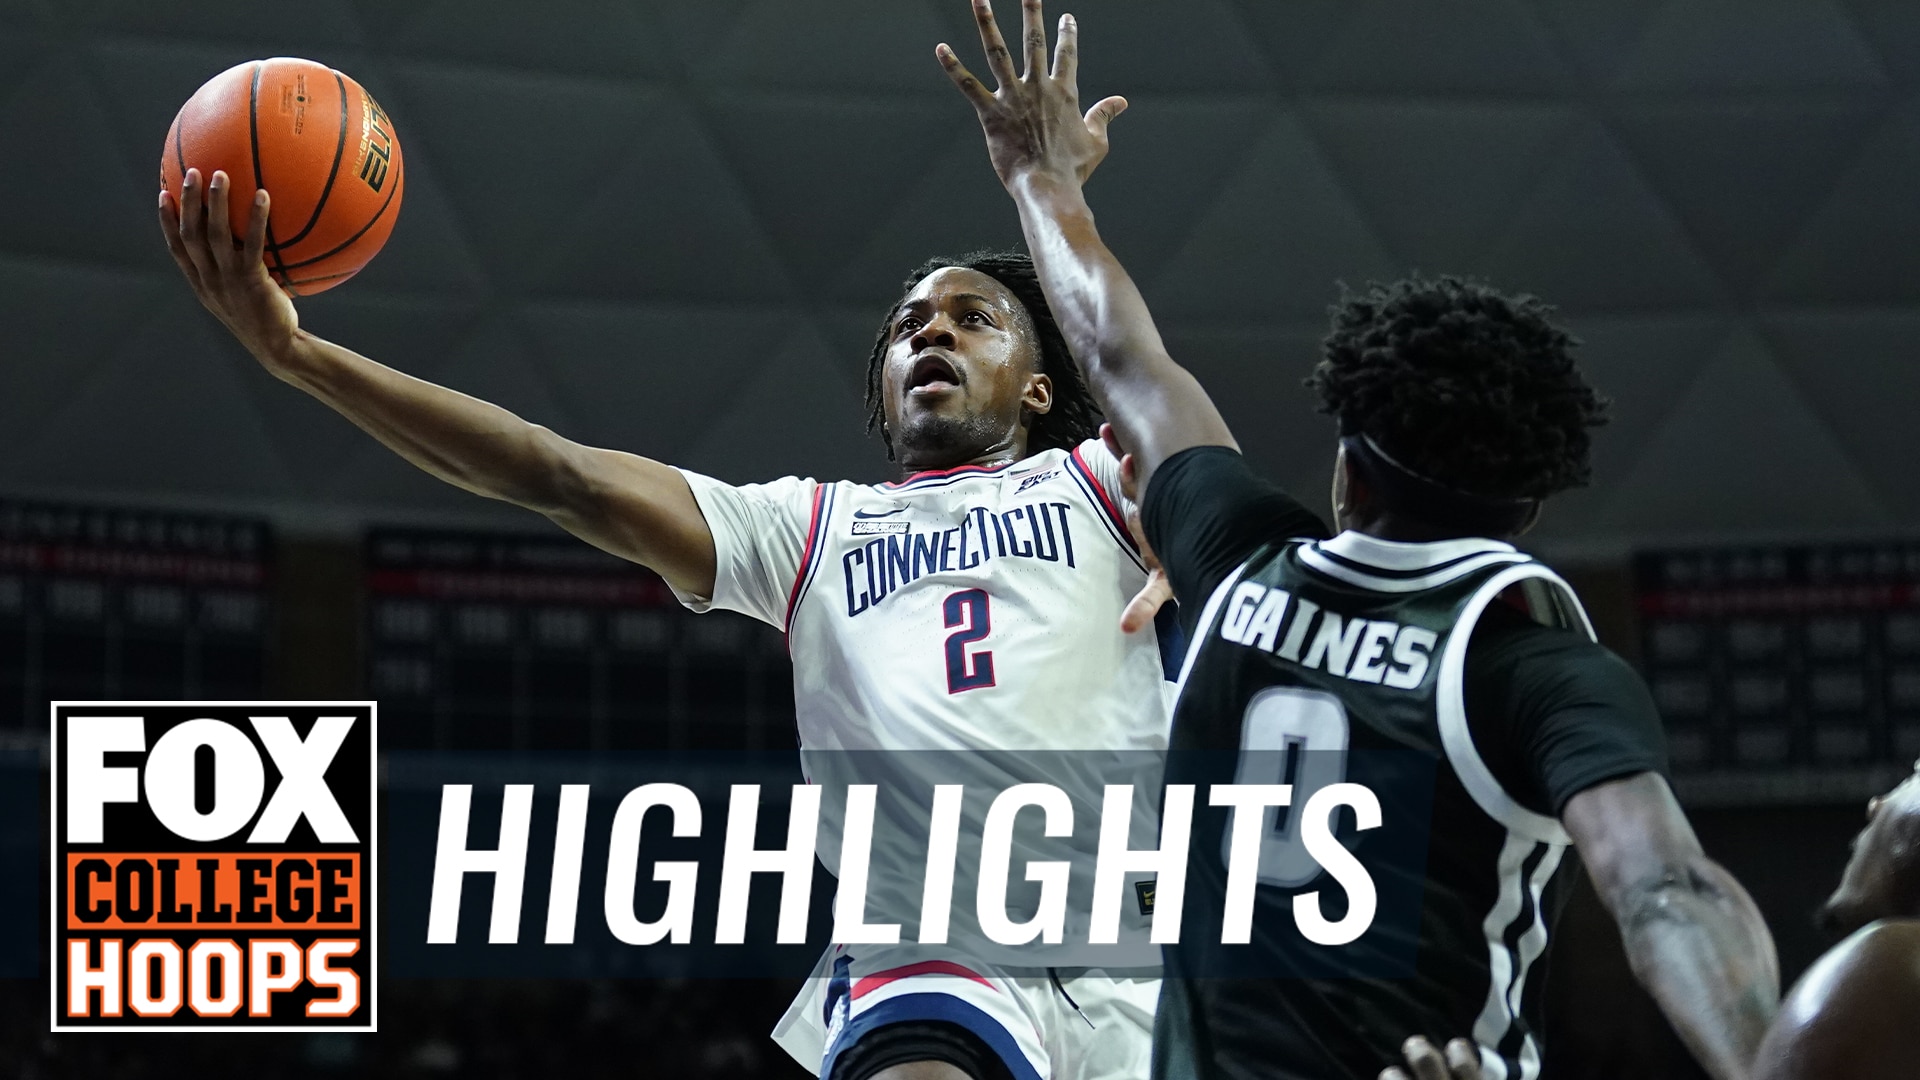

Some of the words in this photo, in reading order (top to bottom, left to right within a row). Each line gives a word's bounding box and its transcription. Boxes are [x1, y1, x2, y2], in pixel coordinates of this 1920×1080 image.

[842, 502, 1075, 617] CONNECTICUT
[942, 587, 996, 694] 2
[1220, 580, 1438, 690] GAINES
[1220, 685, 1350, 888] 0
